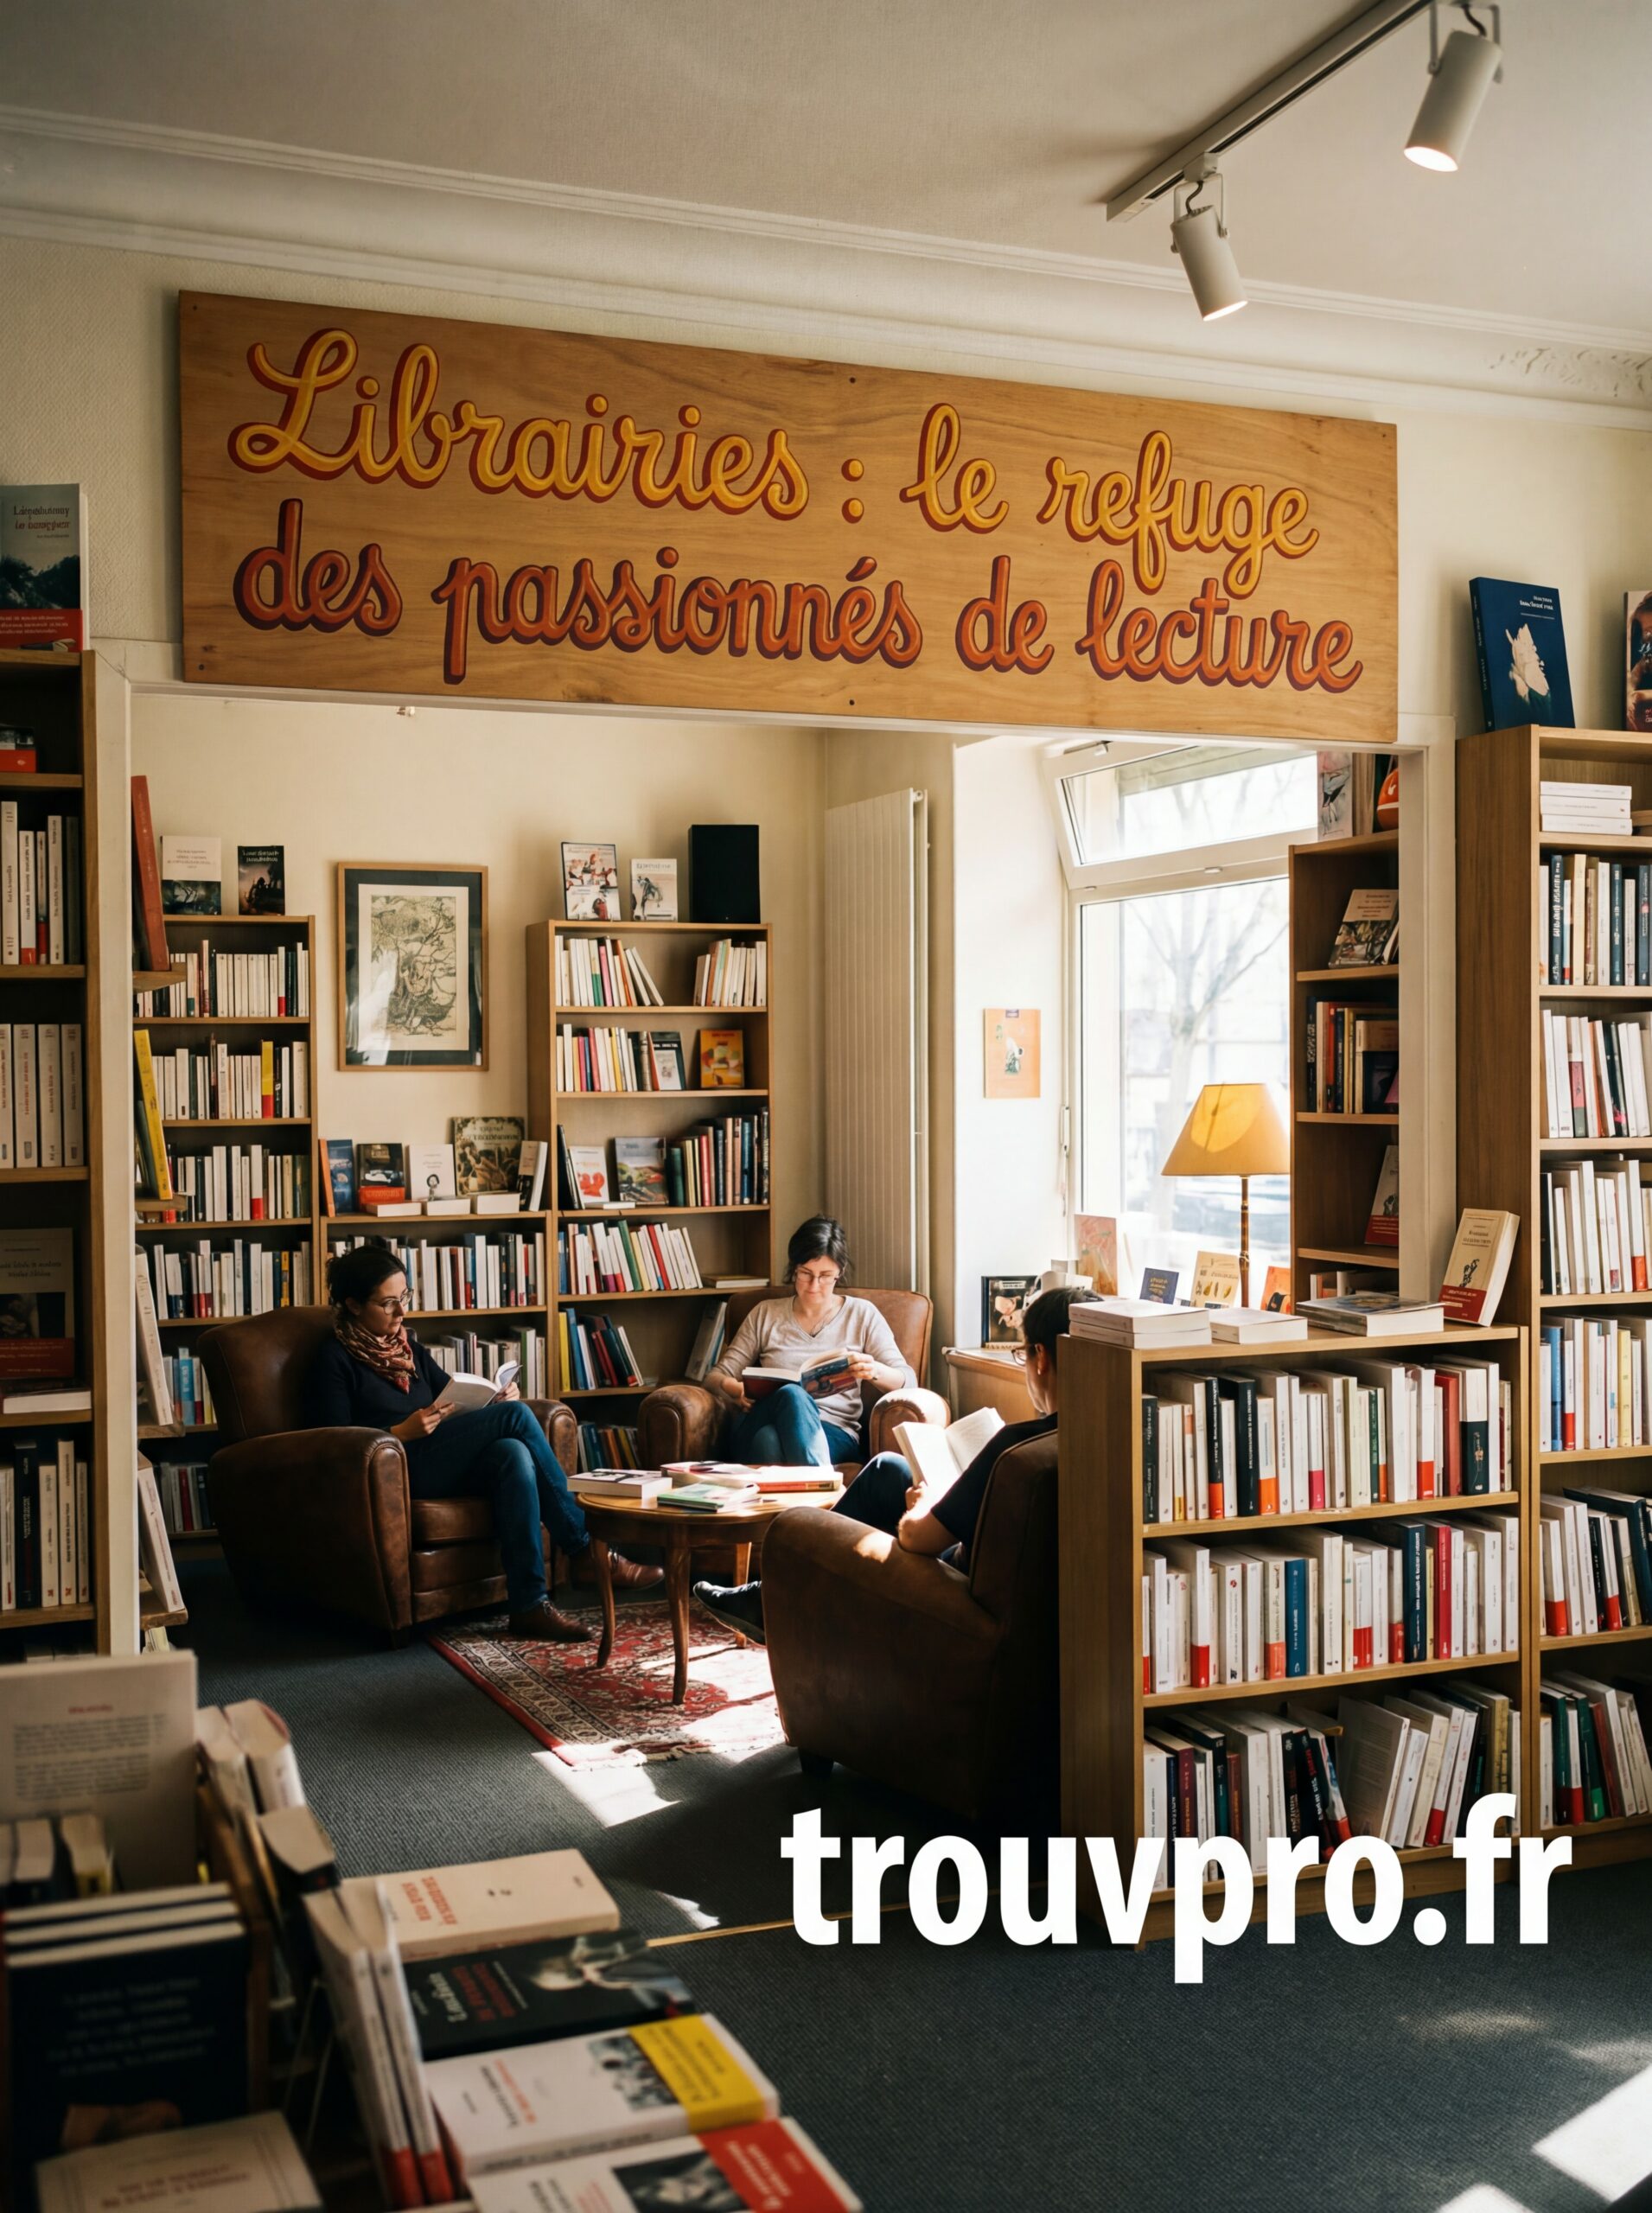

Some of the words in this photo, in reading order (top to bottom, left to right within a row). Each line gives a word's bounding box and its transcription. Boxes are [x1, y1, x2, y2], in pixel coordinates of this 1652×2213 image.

[227, 328, 809, 520] Librairies
[841, 458, 864, 524] :
[899, 402, 1010, 535] le
[1036, 430, 1320, 599] refuge
[233, 497, 403, 637] des
[431, 546, 923, 686] passionnés
[955, 554, 1055, 675] de
[1075, 558, 1363, 694] lecture
